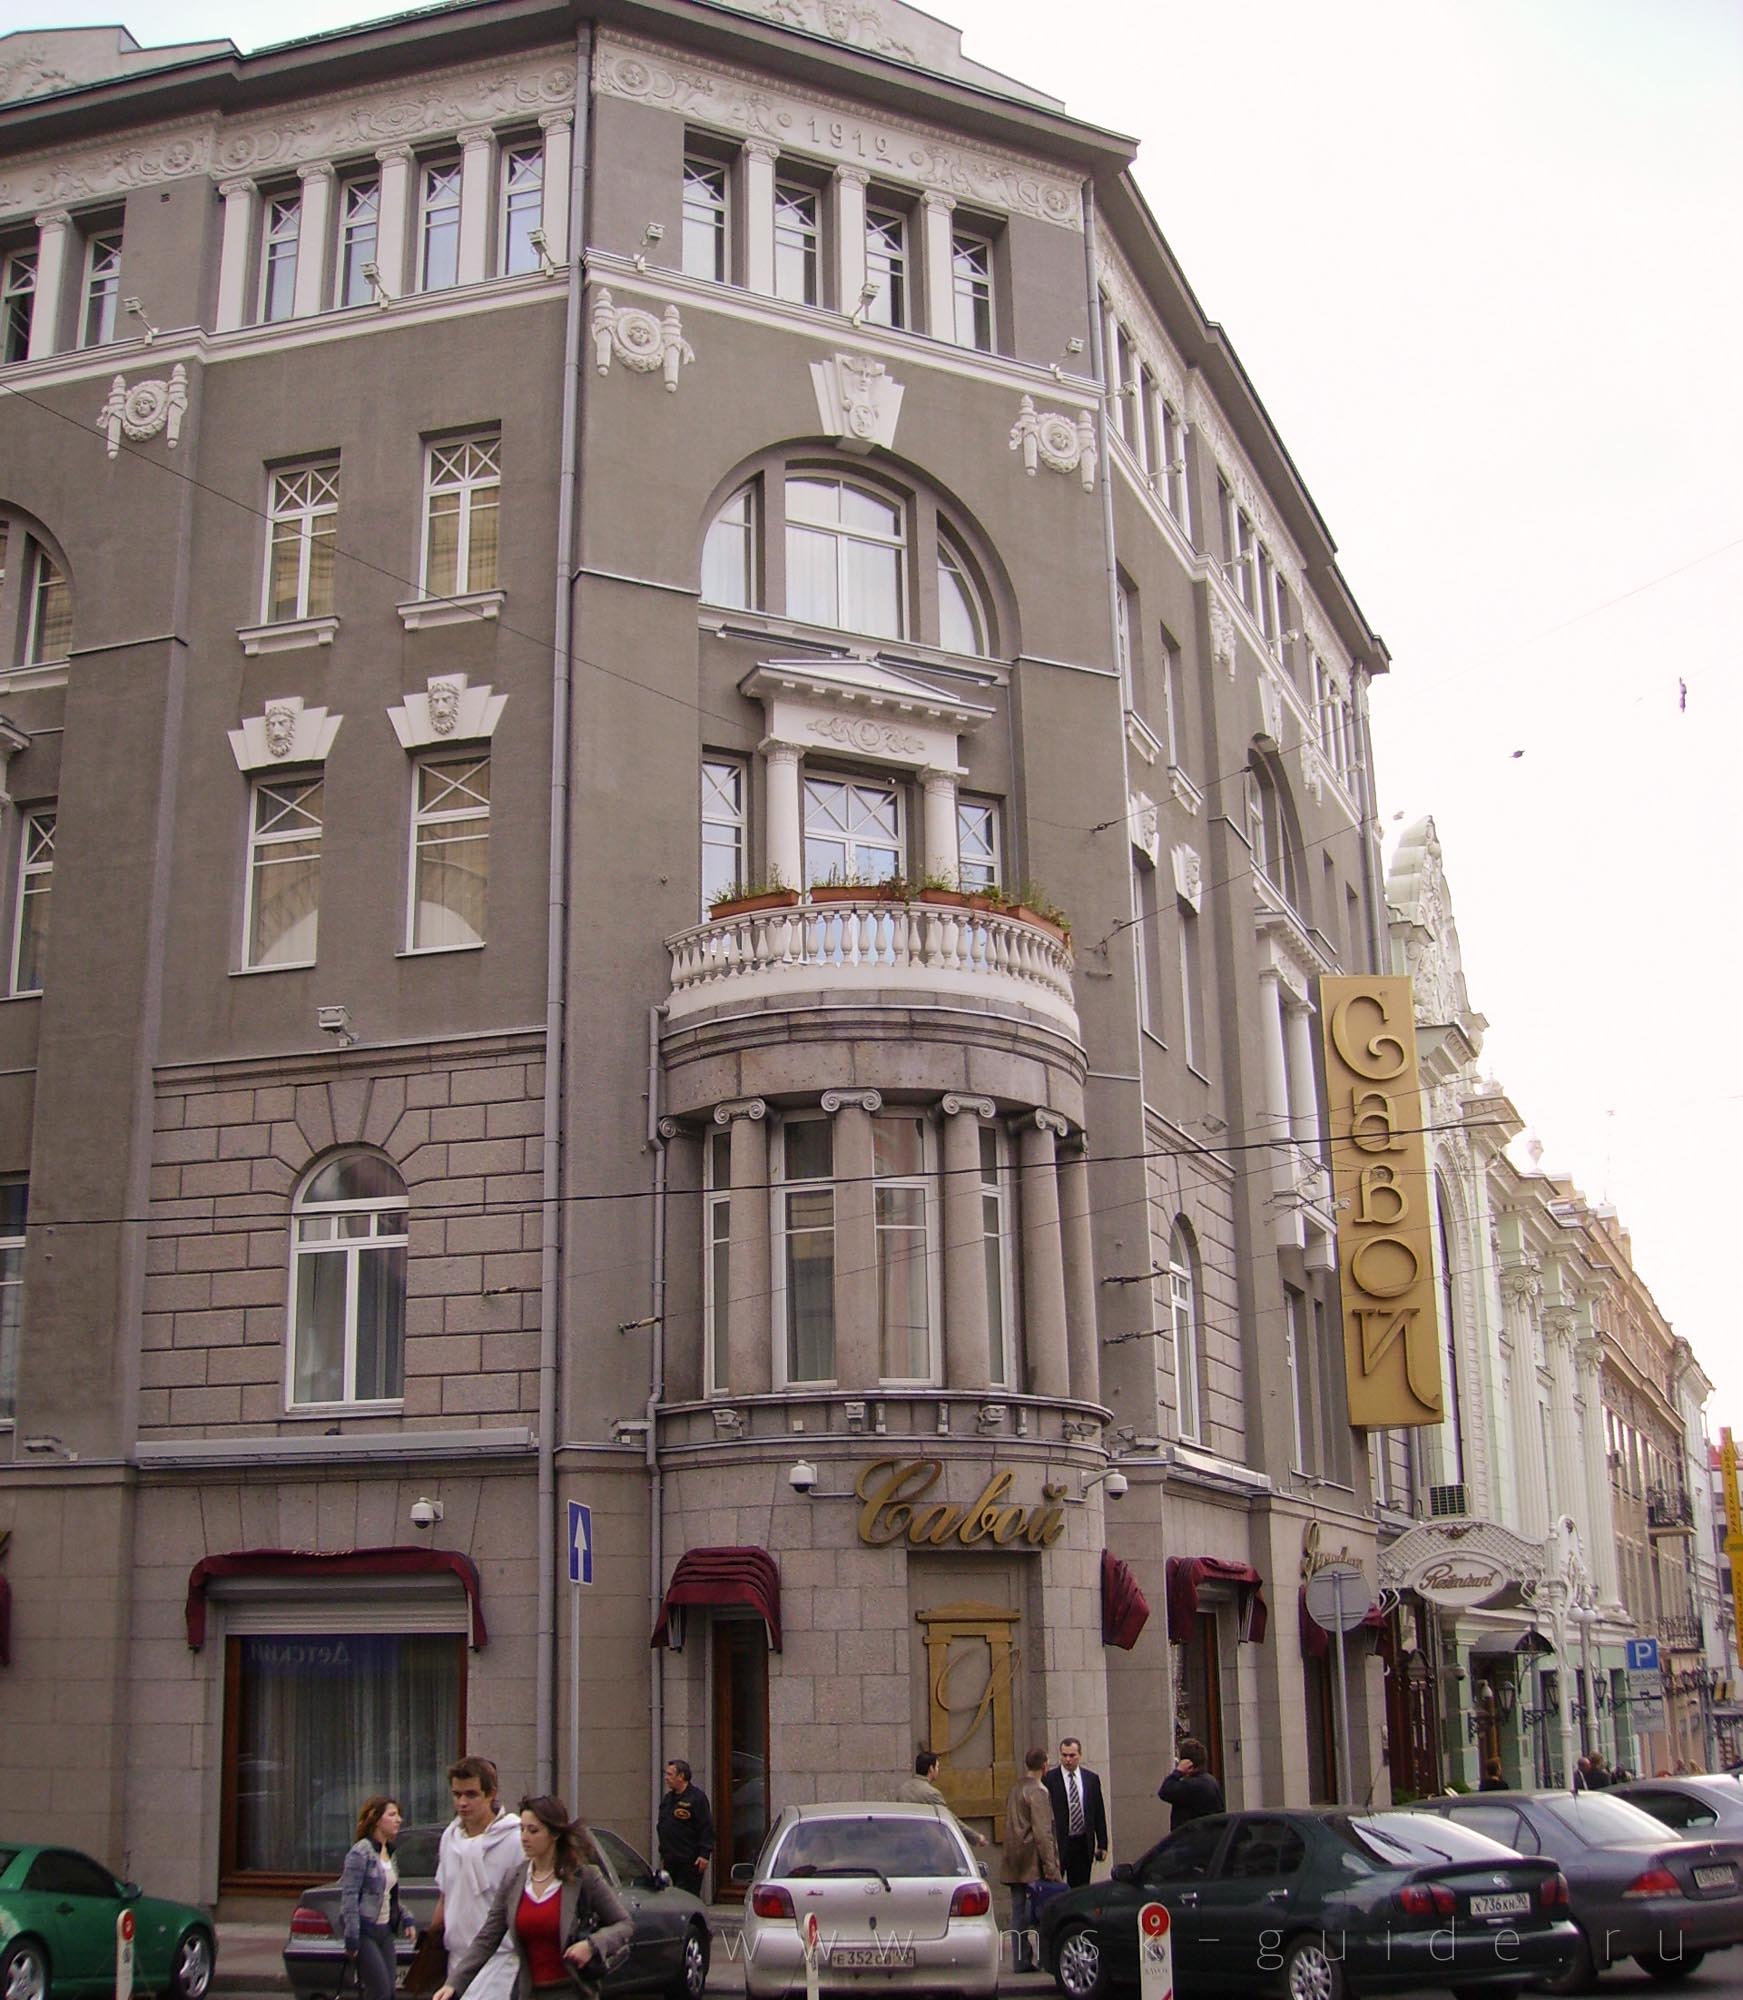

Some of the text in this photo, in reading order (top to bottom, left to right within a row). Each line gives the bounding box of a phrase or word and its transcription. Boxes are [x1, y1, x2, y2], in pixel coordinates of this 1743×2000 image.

[1331, 992, 1440, 1412] Савой
[856, 1457, 1068, 1545] Савой
[1418, 1563, 1498, 1590] Restaurant
[1634, 1642, 1652, 1667] P
